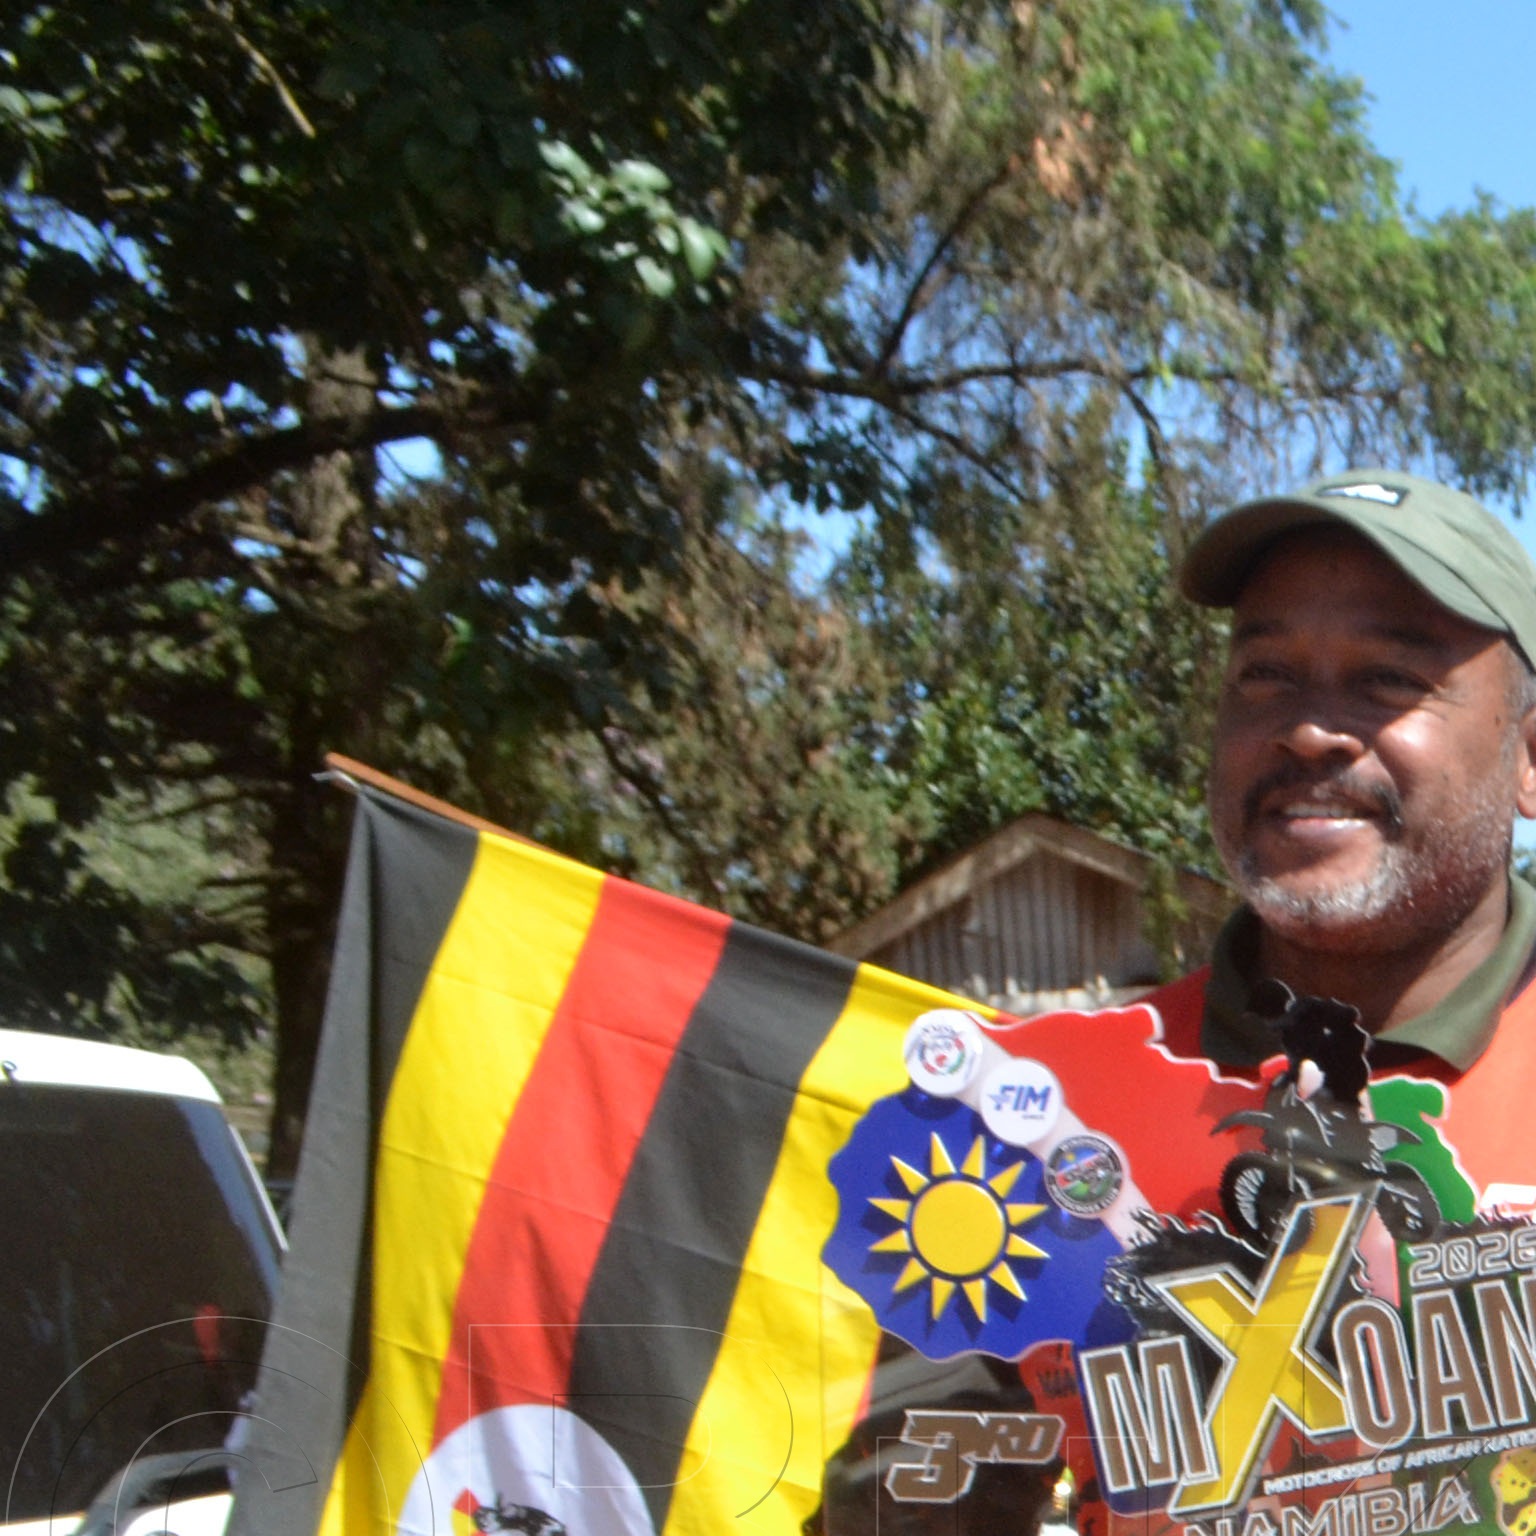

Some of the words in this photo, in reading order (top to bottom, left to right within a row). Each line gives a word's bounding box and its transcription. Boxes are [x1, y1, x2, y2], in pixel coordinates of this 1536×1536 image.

[993, 1085, 1053, 1112] FIM
[1263, 1462, 1376, 1497] MOTOCROSS
[1376, 1456, 1402, 1476] OF
[1404, 1439, 1483, 1470] AFRICAN
